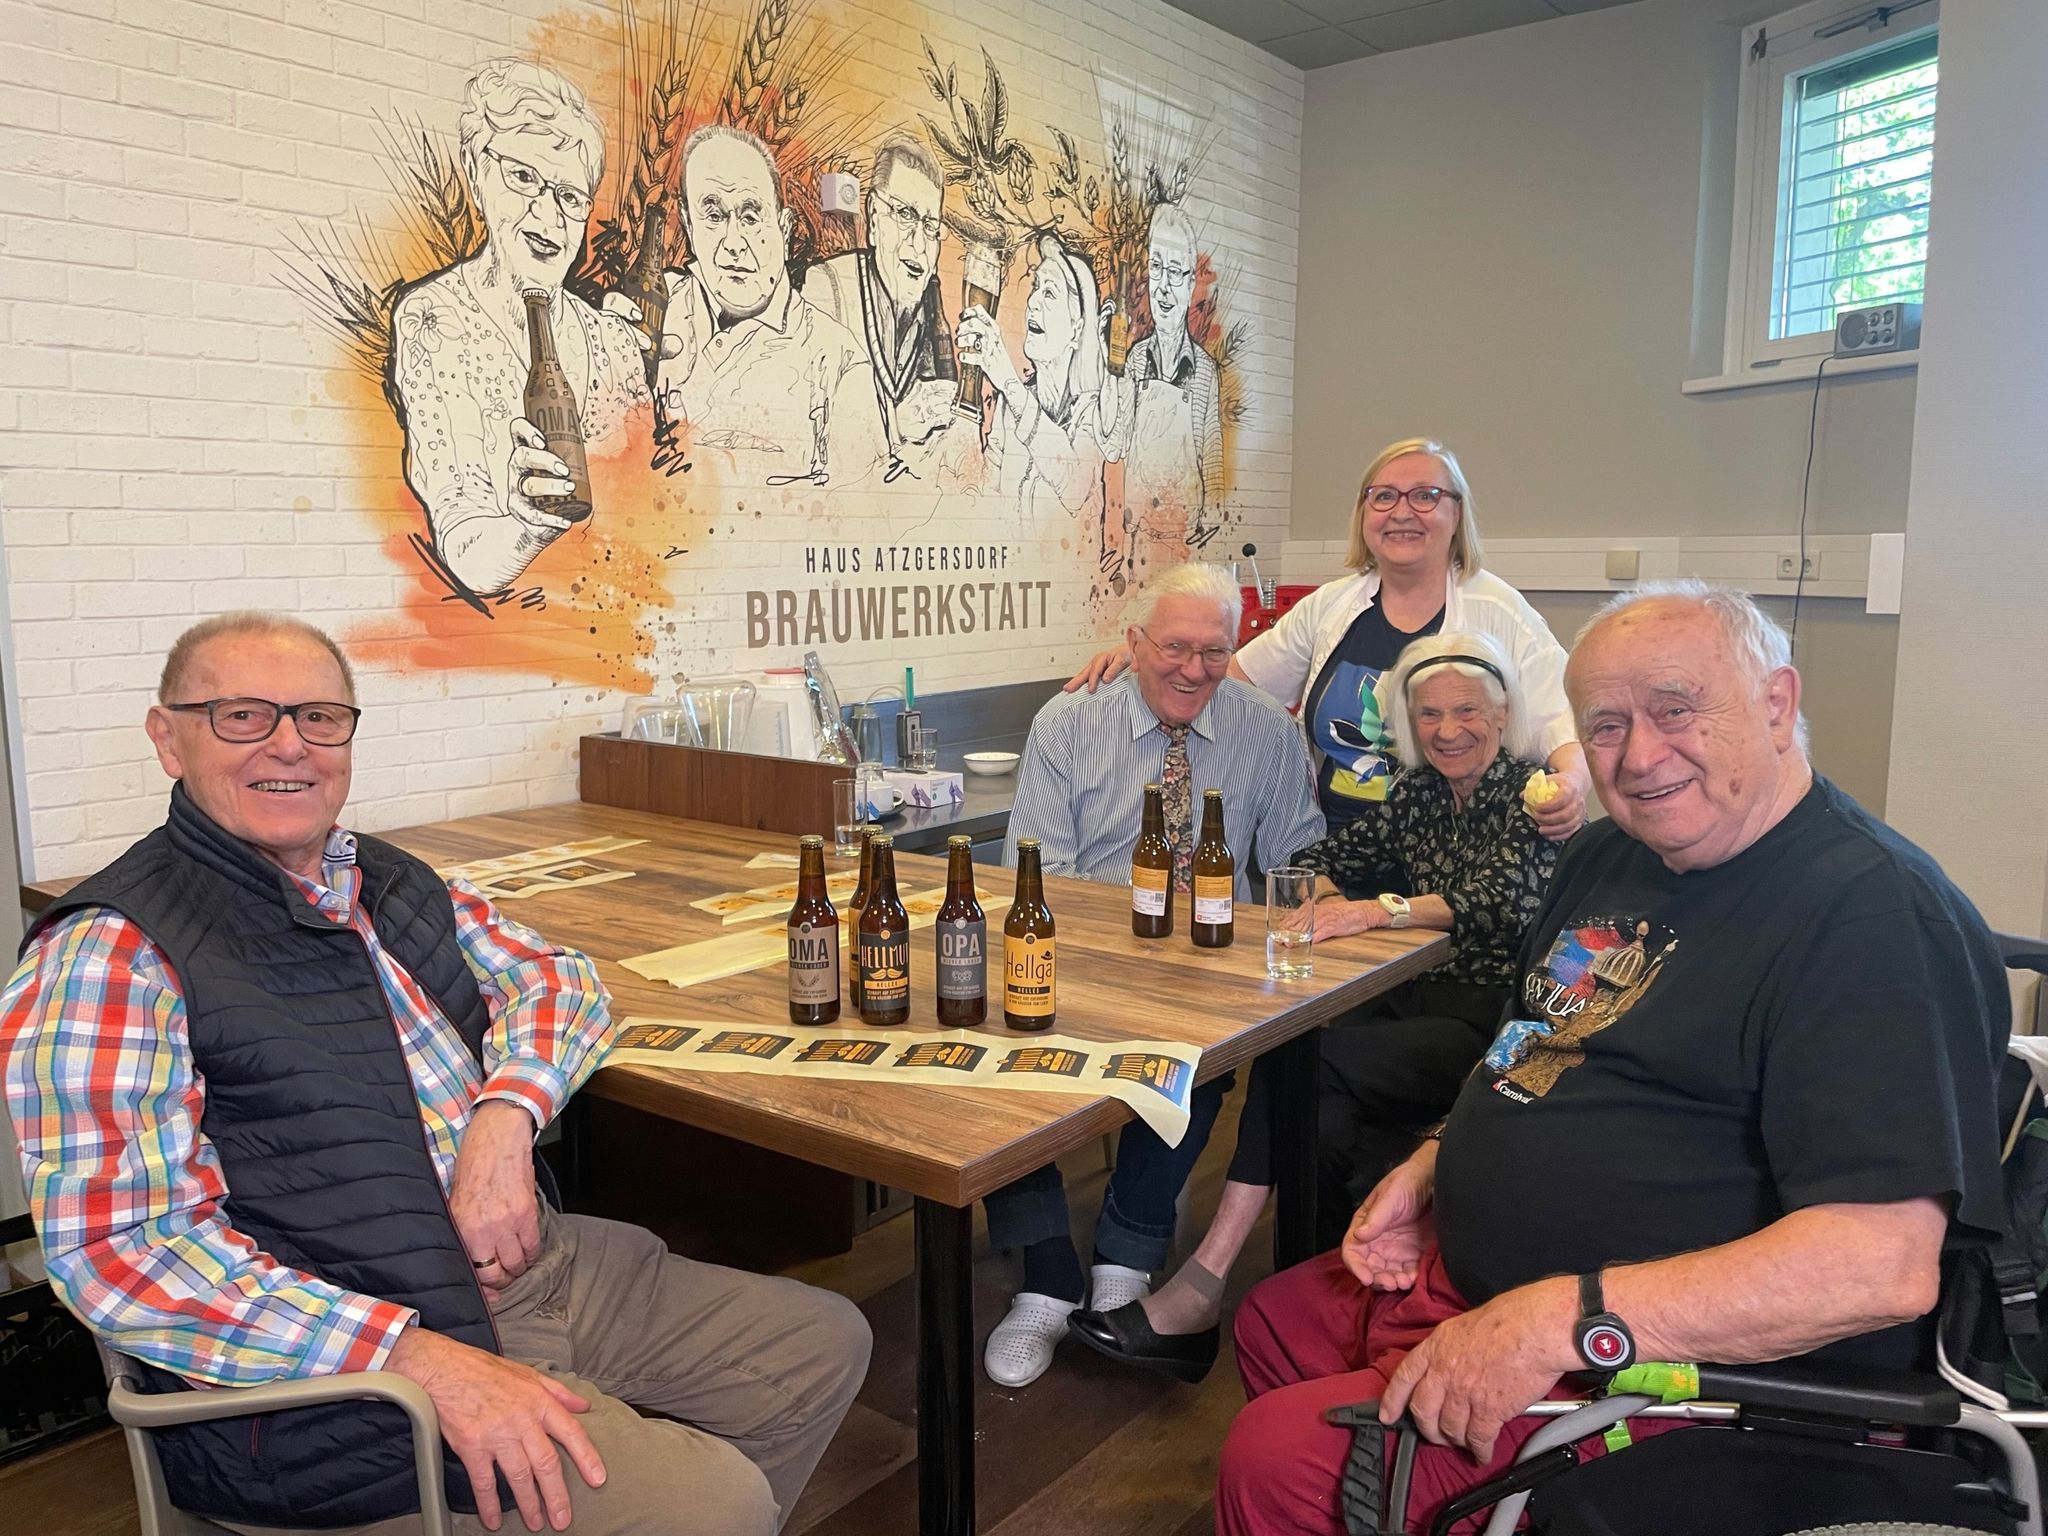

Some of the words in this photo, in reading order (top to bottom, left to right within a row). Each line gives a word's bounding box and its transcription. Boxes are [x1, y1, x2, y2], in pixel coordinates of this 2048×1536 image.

[536, 406, 578, 434] OMA
[805, 547, 862, 574] HAUS
[875, 546, 1010, 573] ATZGERSDORF
[746, 580, 1052, 649] BRAUWERKSTATT
[789, 937, 829, 961] OMA
[861, 942, 908, 969] HELLMUT
[942, 933, 980, 958] OPA
[1006, 950, 1052, 985] Hellga
[1499, 1085, 1534, 1105] Carnival
